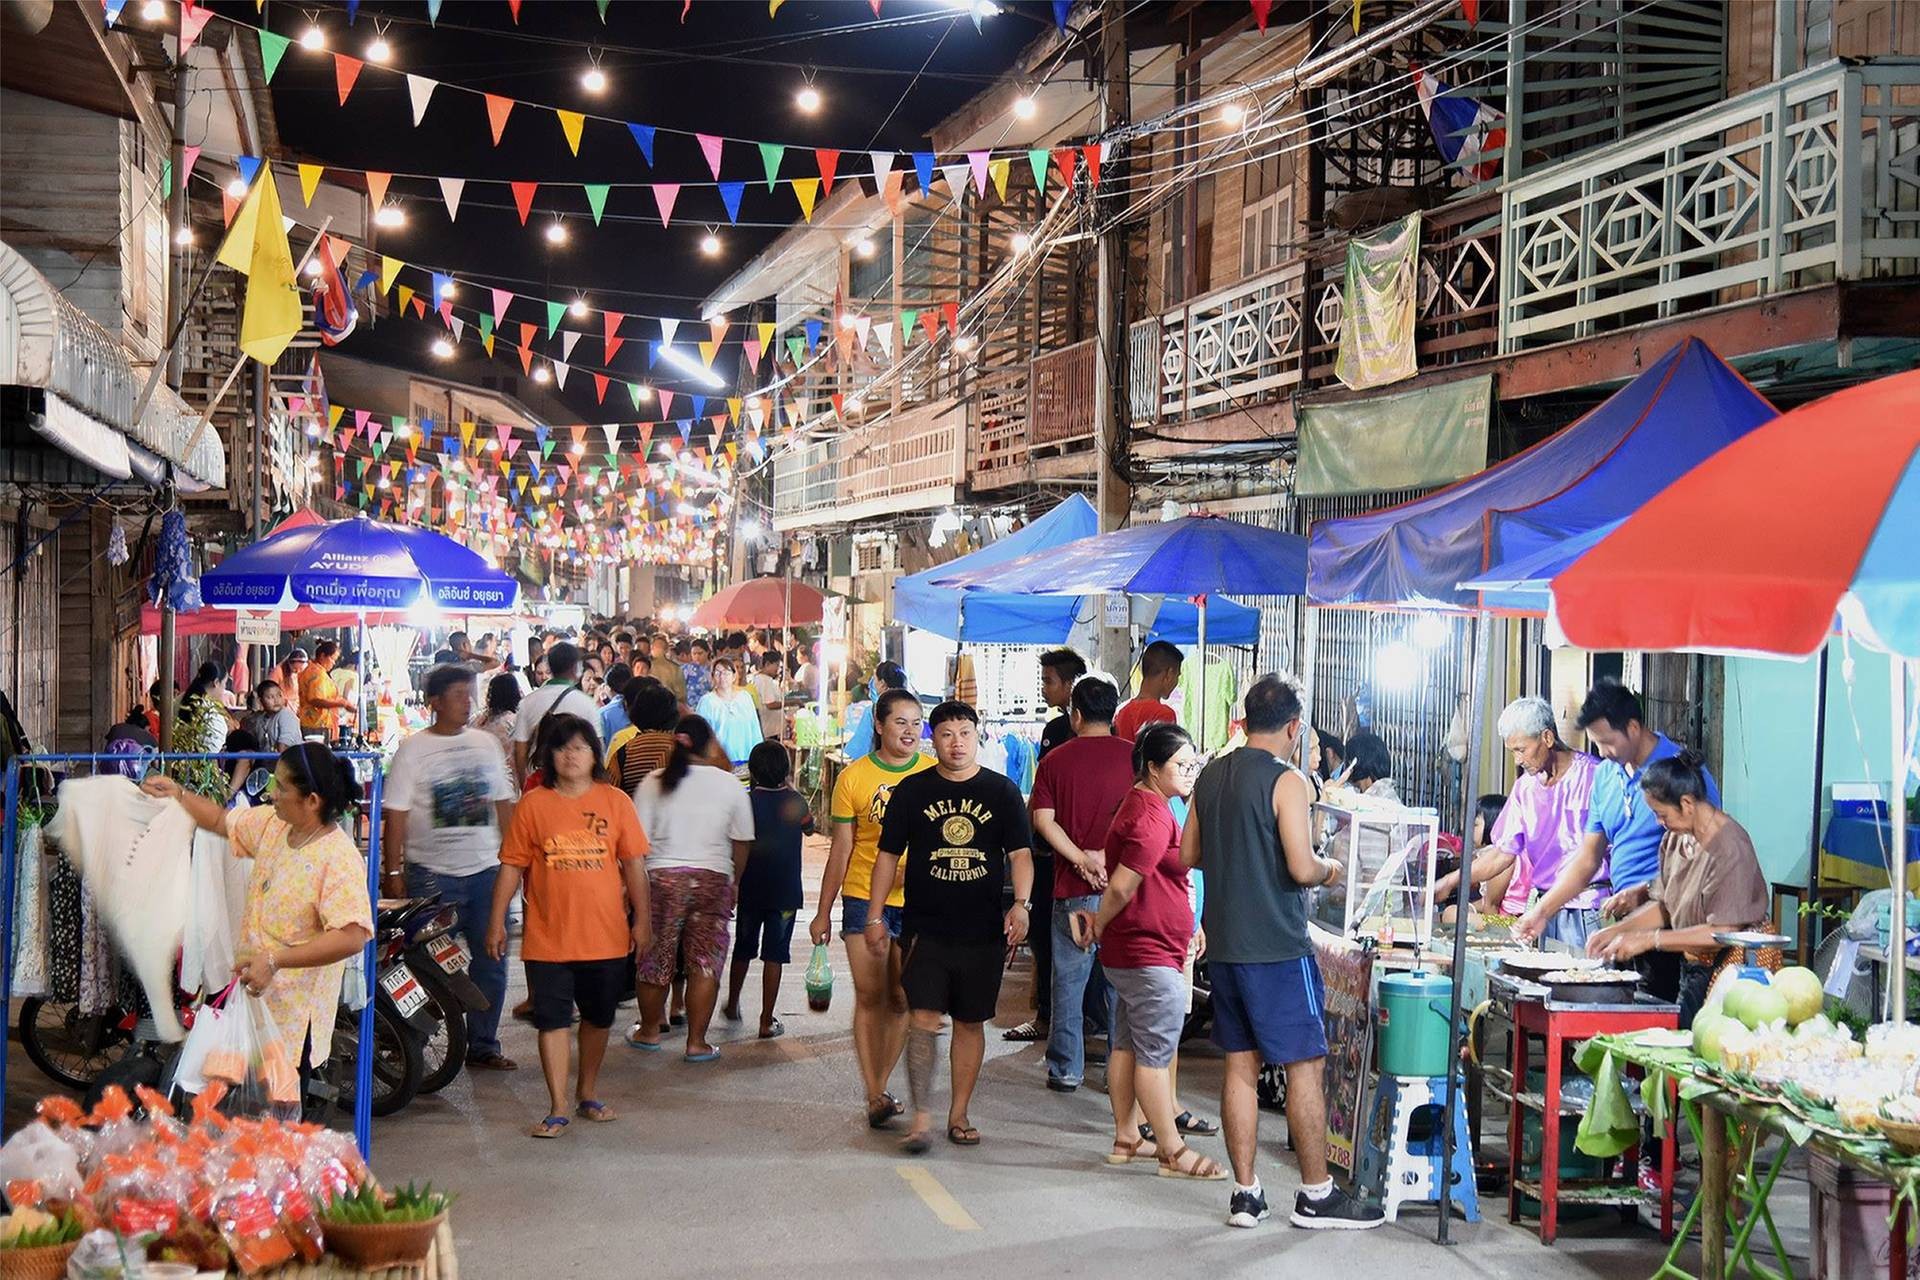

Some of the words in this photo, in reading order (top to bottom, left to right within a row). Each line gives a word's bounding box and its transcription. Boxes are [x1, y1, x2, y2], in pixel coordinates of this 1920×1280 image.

[321, 552, 369, 562] Allianz
[305, 577, 348, 600] ทุกเมื่อ
[351, 578, 401, 603] เพื่อคุณ
[472, 589, 504, 606] อยุธยา
[923, 799, 957, 822] MEL
[582, 811, 609, 837] 72
[929, 864, 989, 881] CALIFORNIA
[953, 859, 967, 869] 82
